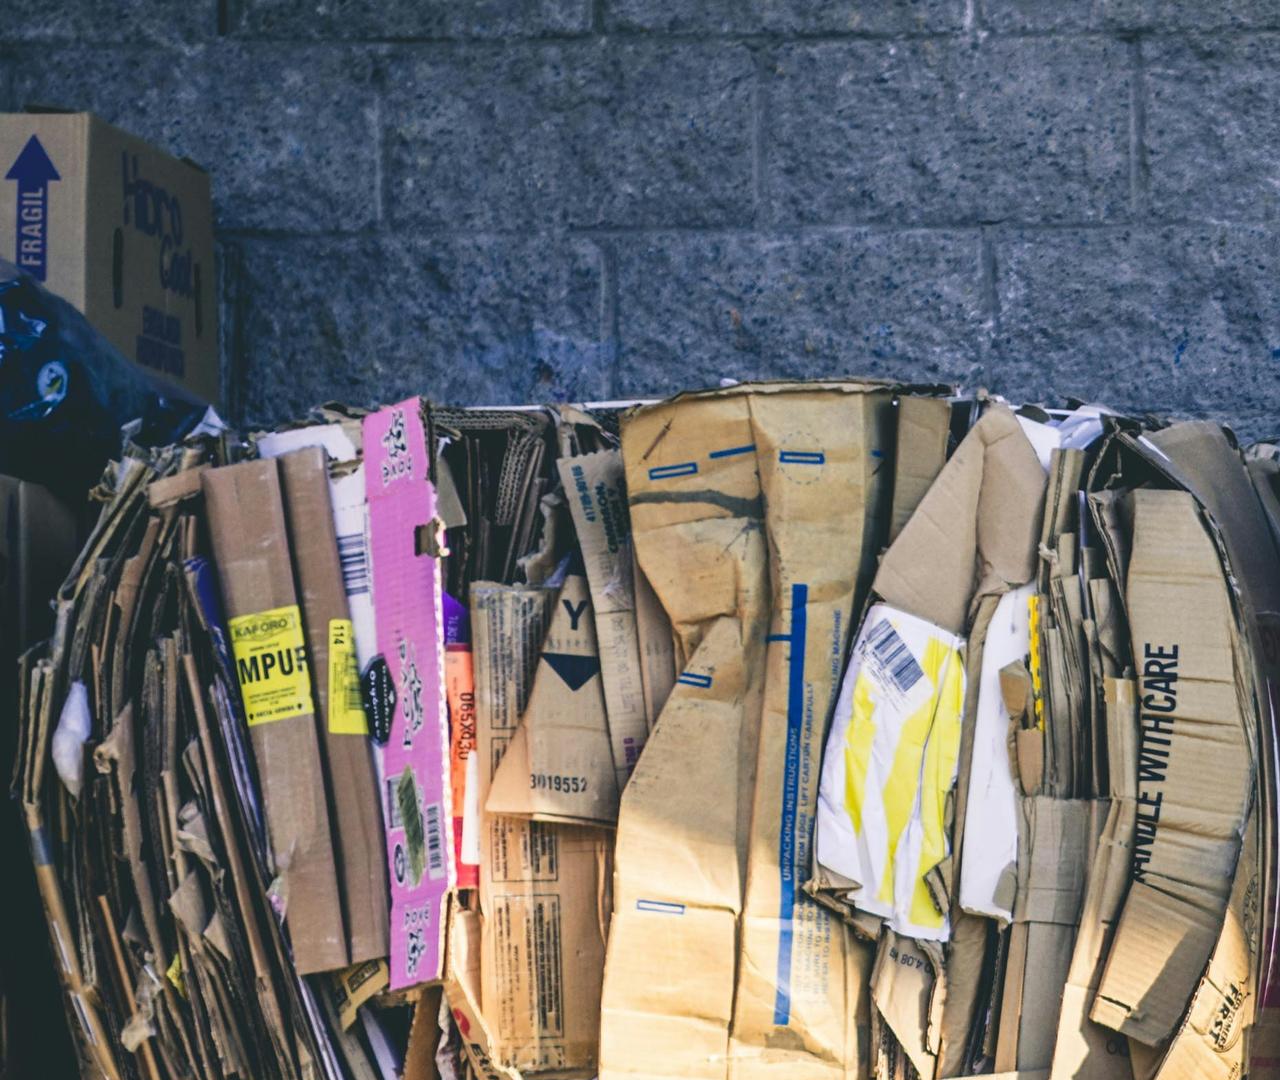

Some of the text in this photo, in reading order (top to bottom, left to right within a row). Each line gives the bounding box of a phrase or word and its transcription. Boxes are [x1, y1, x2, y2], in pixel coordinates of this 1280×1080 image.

[21, 186, 43, 266] FRAGIL
[333, 625, 345, 645] 114
[562, 599, 589, 631] Y
[832, 608, 842, 651] MACHINE
[1142, 642, 1179, 713] CARE
[801, 784, 809, 807] LIFT
[805, 682, 814, 741] CAREFULLY
[1138, 713, 1174, 782] WITH
[783, 727, 798, 881] UNPACKING INSTRUCTIONS
[1208, 983, 1238, 1046] FIRST
